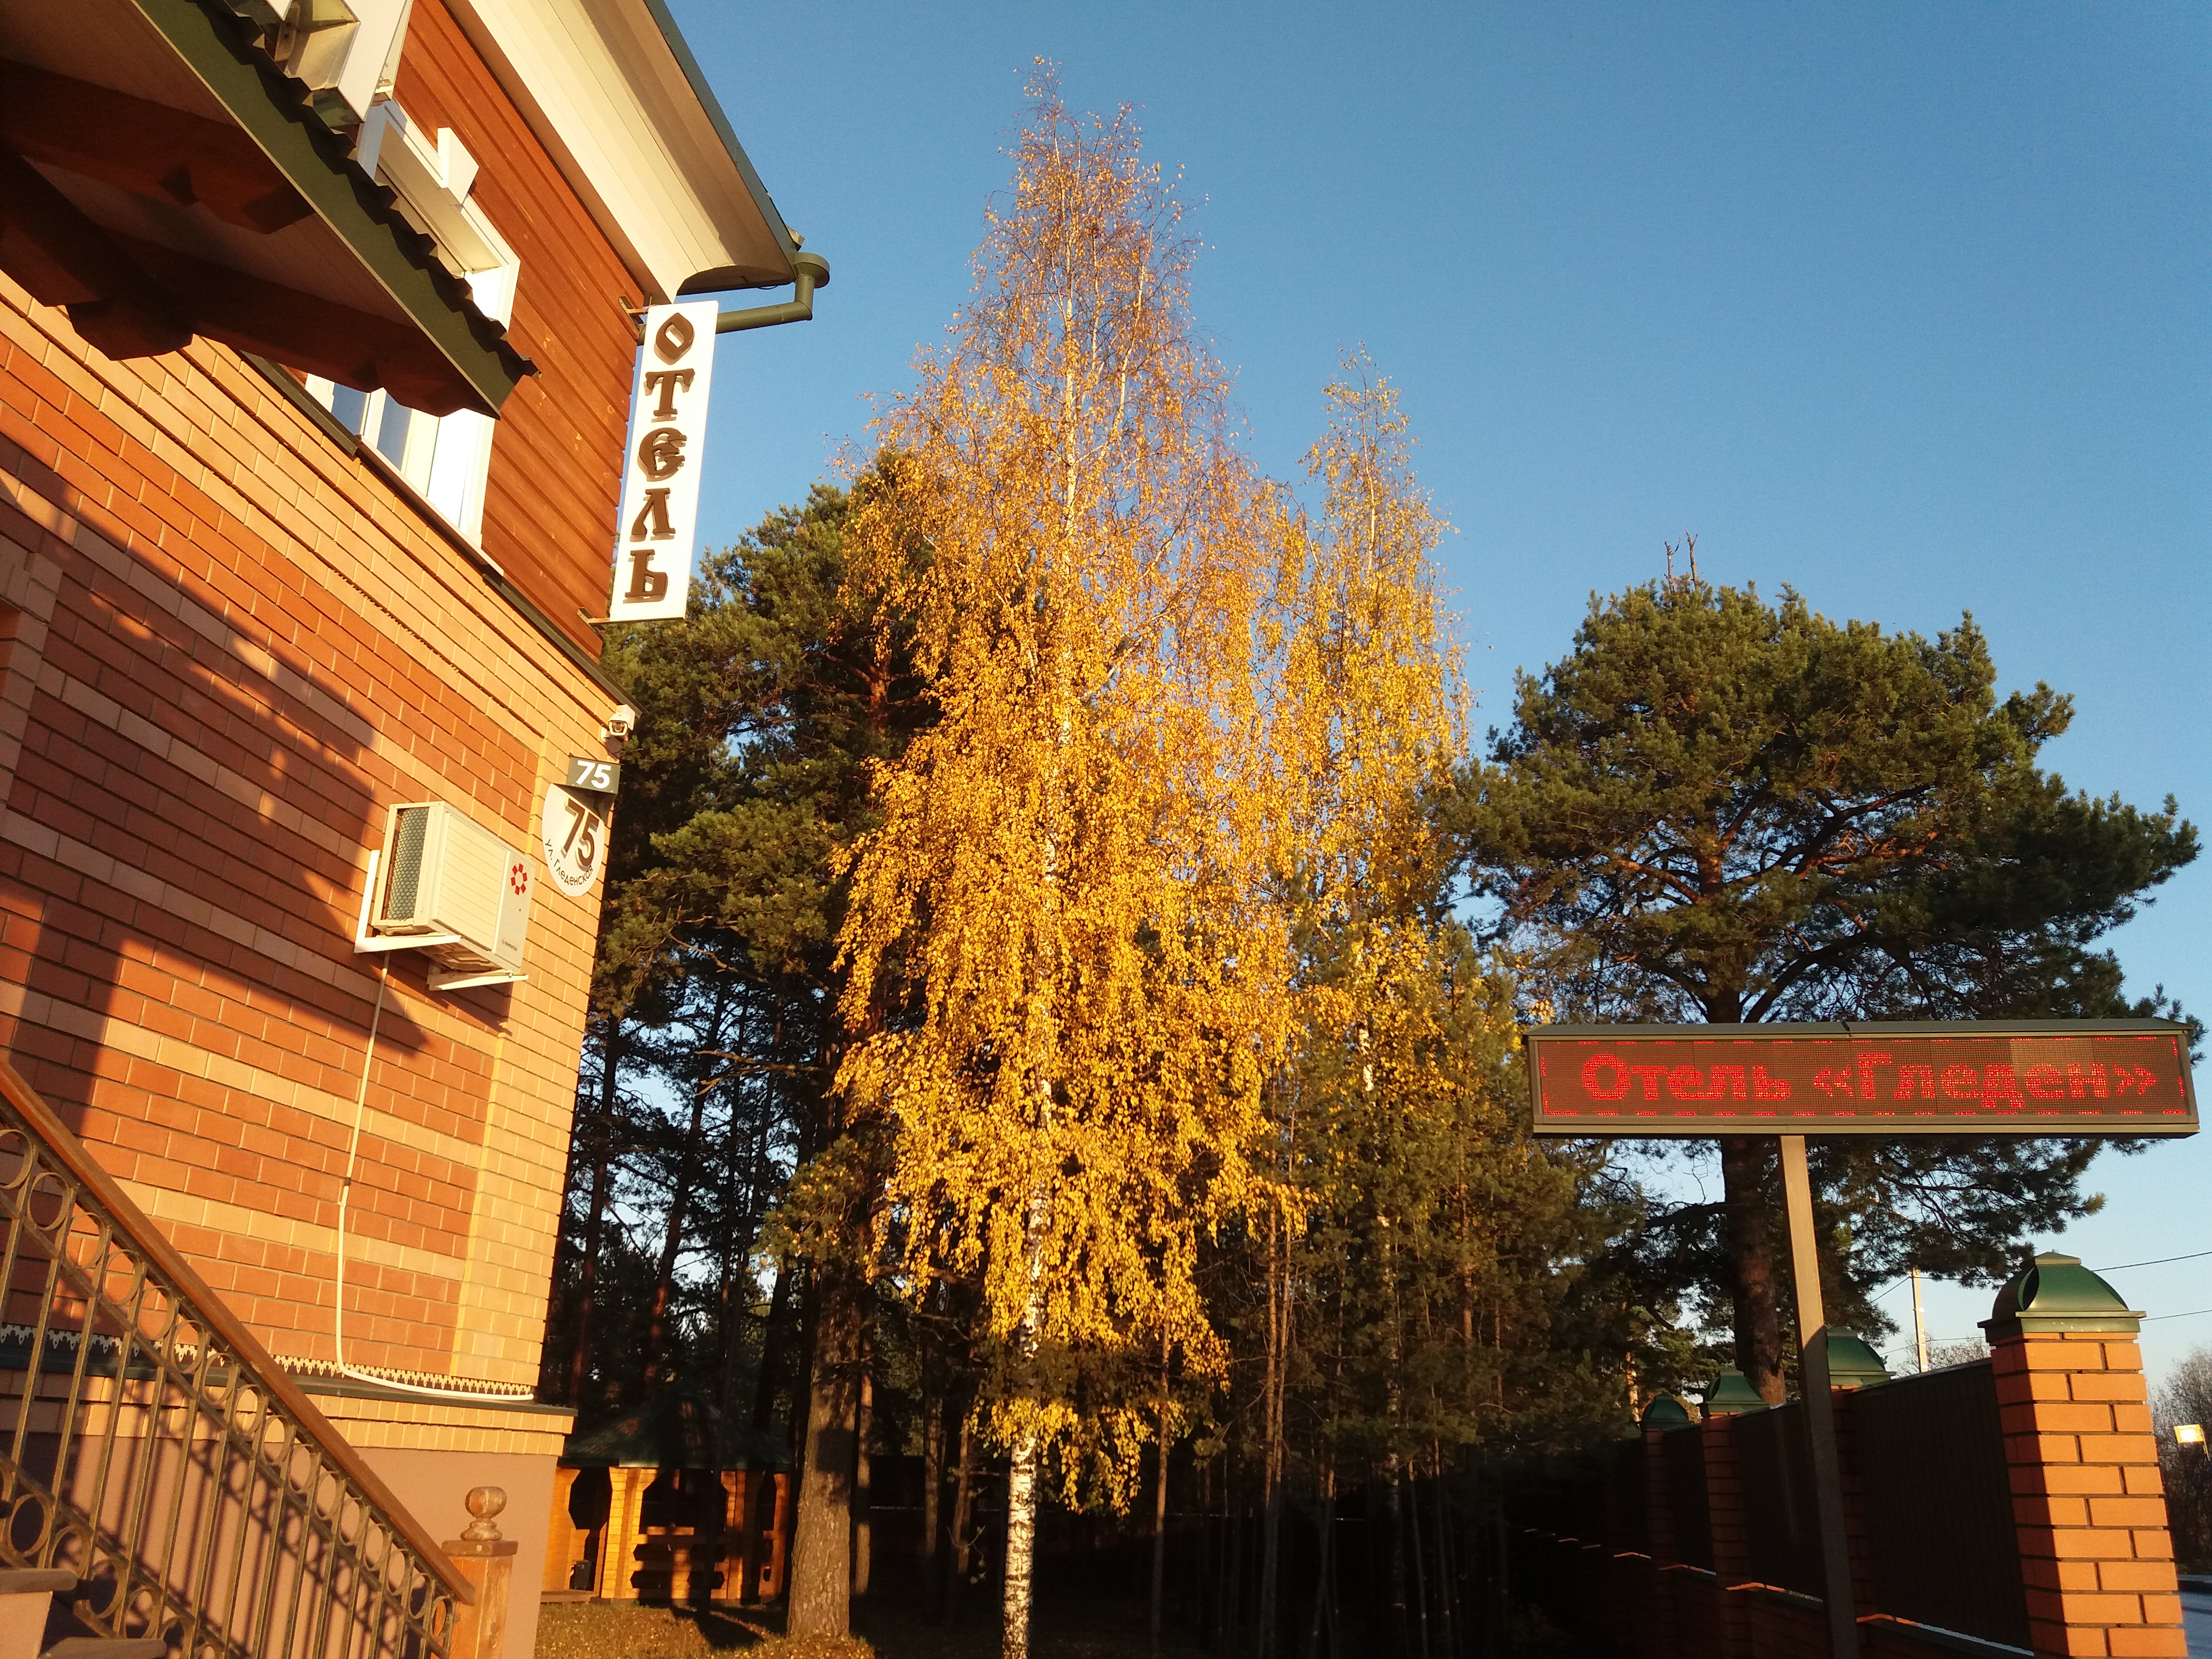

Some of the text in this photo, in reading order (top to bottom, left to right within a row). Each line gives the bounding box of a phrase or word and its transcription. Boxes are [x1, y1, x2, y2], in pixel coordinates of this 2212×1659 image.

[624, 312, 696, 601] ОТЕЛЬ
[576, 760, 611, 789] 75
[566, 797, 600, 868] 75
[544, 839, 593, 886] ул. Гледенская
[1582, 1054, 1791, 1100] Отель
